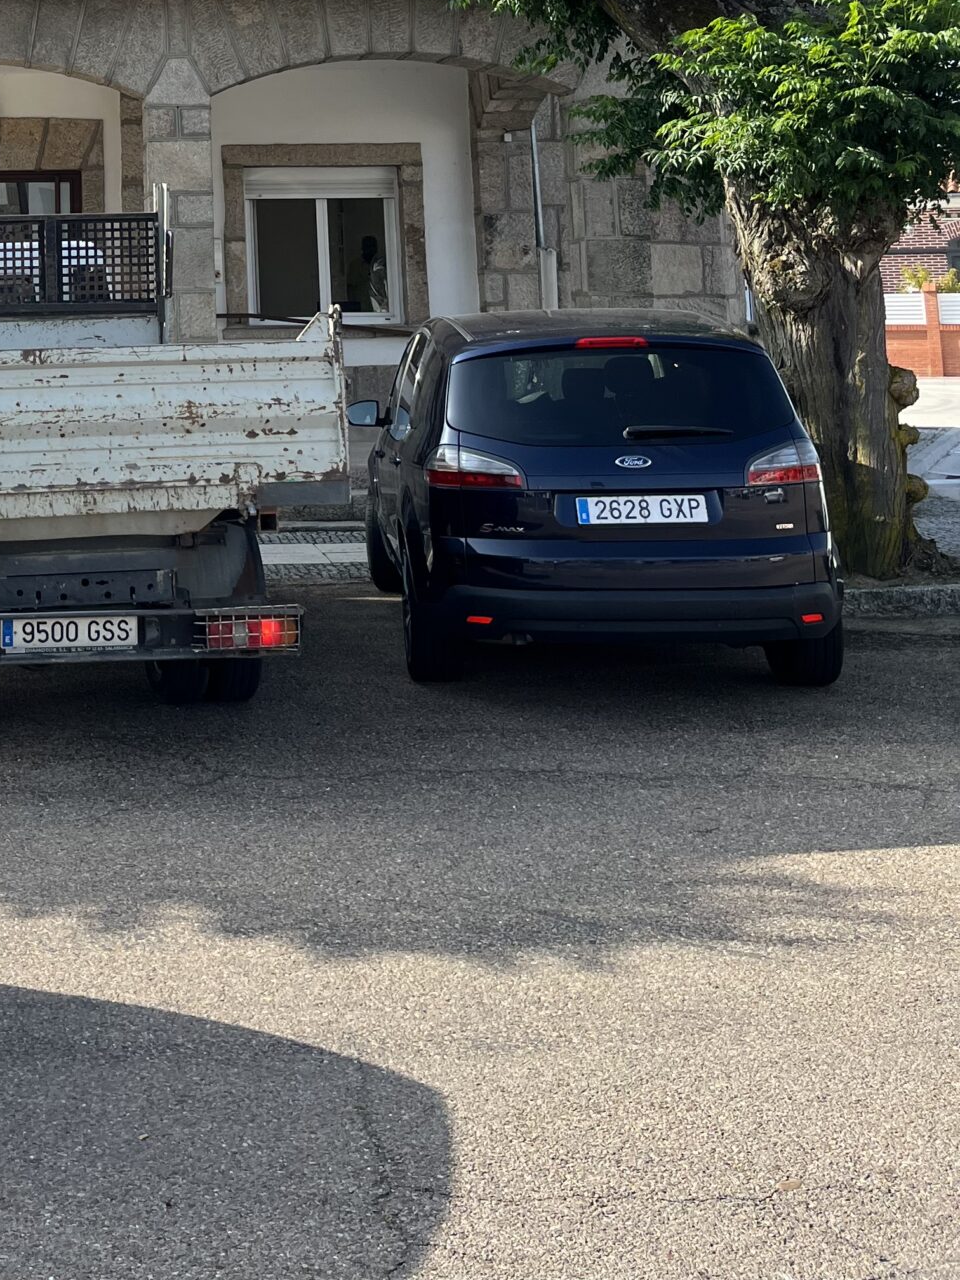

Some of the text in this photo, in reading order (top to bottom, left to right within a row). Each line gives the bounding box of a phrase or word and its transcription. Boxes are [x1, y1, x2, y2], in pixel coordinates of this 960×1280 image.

[594, 499, 651, 520] 2628
[659, 498, 700, 519] GXP
[22, 619, 130, 643] 9500 GSS
